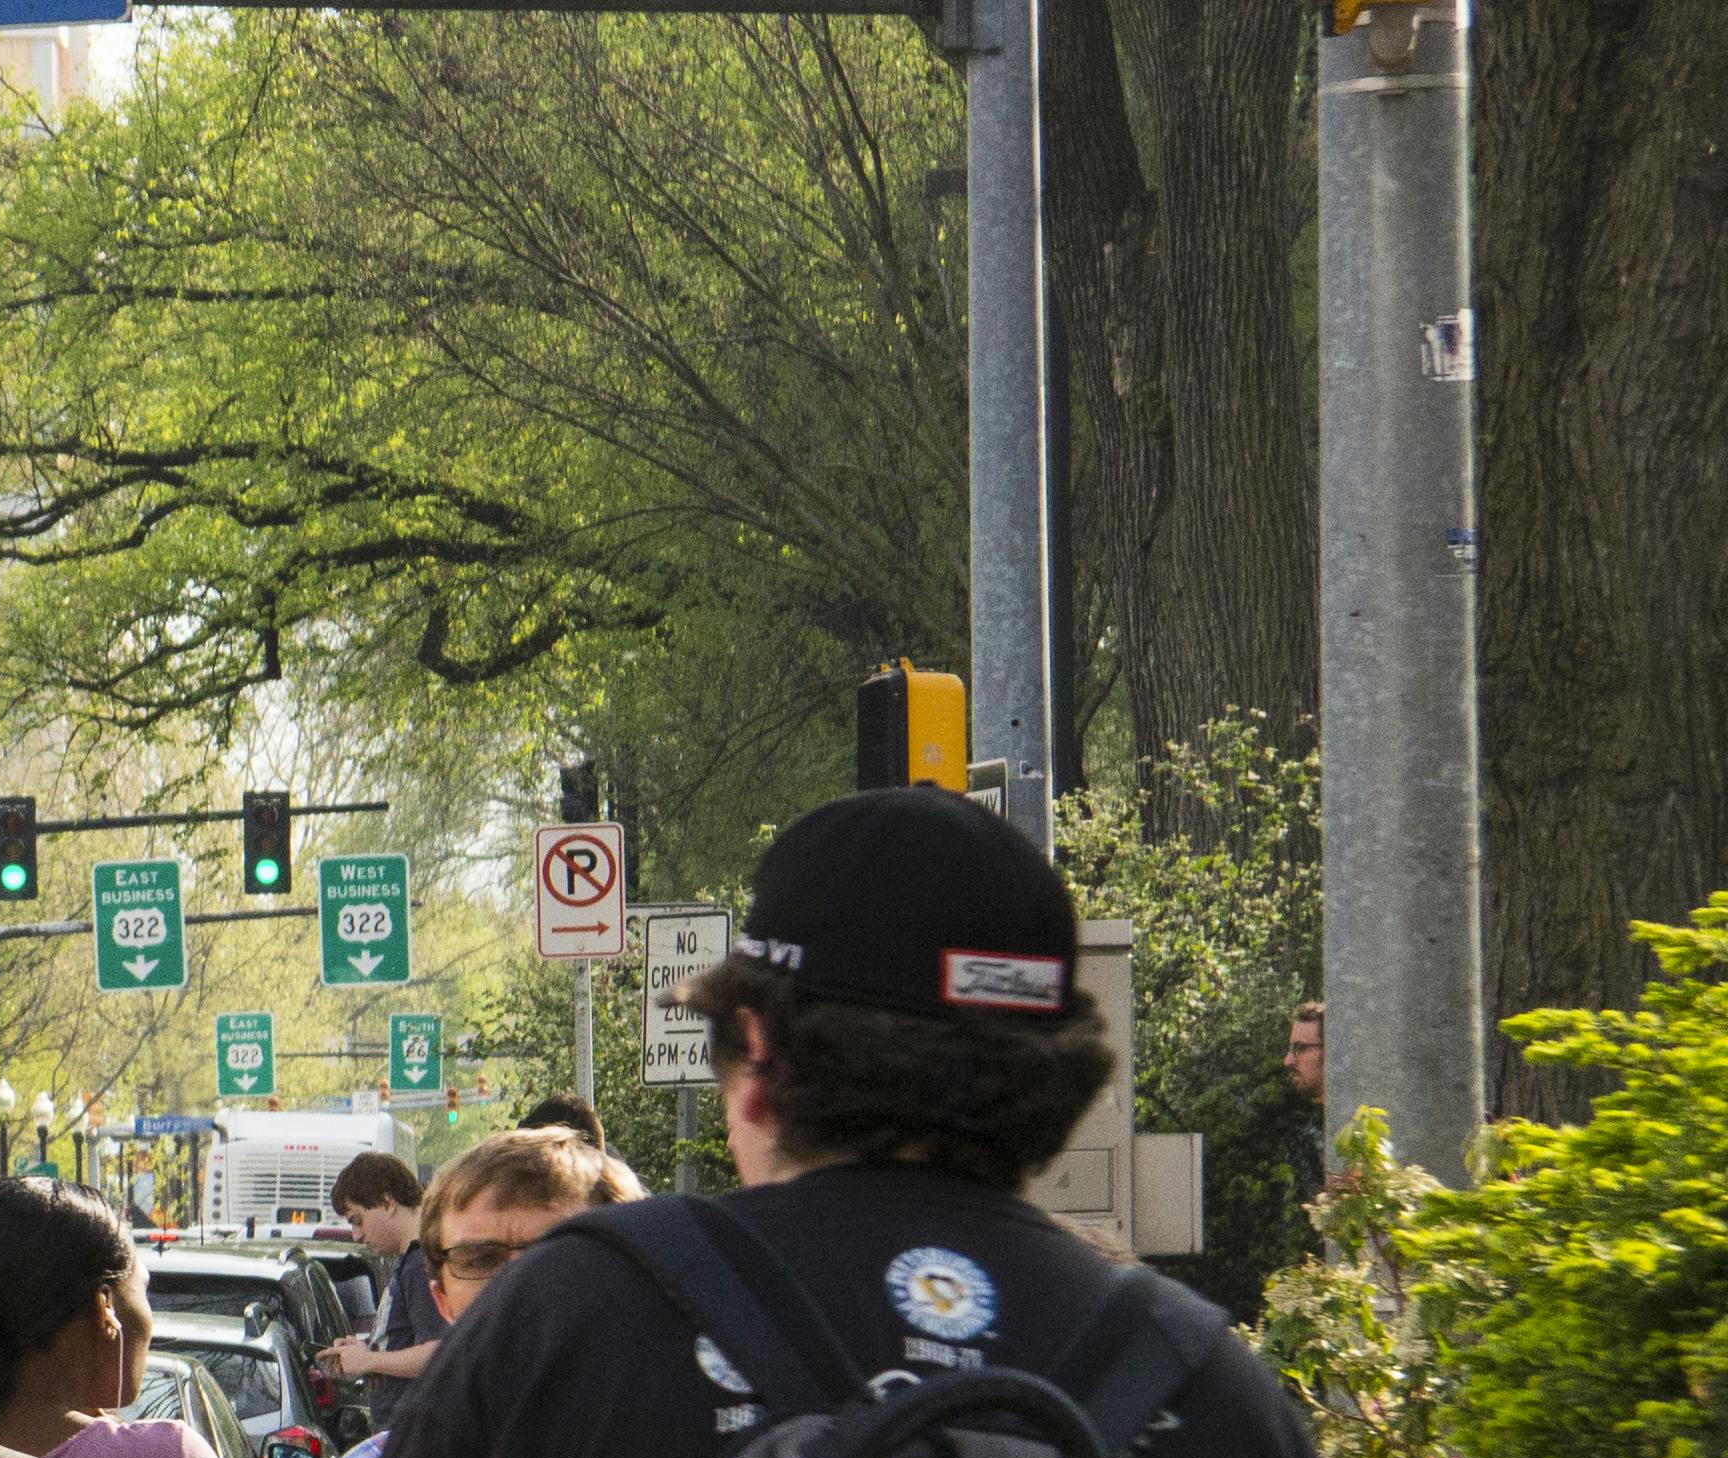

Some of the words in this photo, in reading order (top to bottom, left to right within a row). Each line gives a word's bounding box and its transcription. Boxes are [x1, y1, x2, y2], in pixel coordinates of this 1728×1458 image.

[115, 869, 159, 886] EAST
[340, 864, 386, 880] WEST
[101, 887, 175, 904] BUSINESS
[327, 883, 401, 899] BUSINESS
[117, 916, 160, 939] 322
[342, 911, 385, 934] 322
[676, 931, 697, 955] NO
[651, 965, 712, 989] CRUI
[228, 1017, 259, 1029] EAST
[398, 1020, 435, 1033] SOUTH
[220, 1030, 269, 1041] BUSINESS
[231, 1049, 259, 1064] 322
[646, 1041, 711, 1067] 6PM-6A
